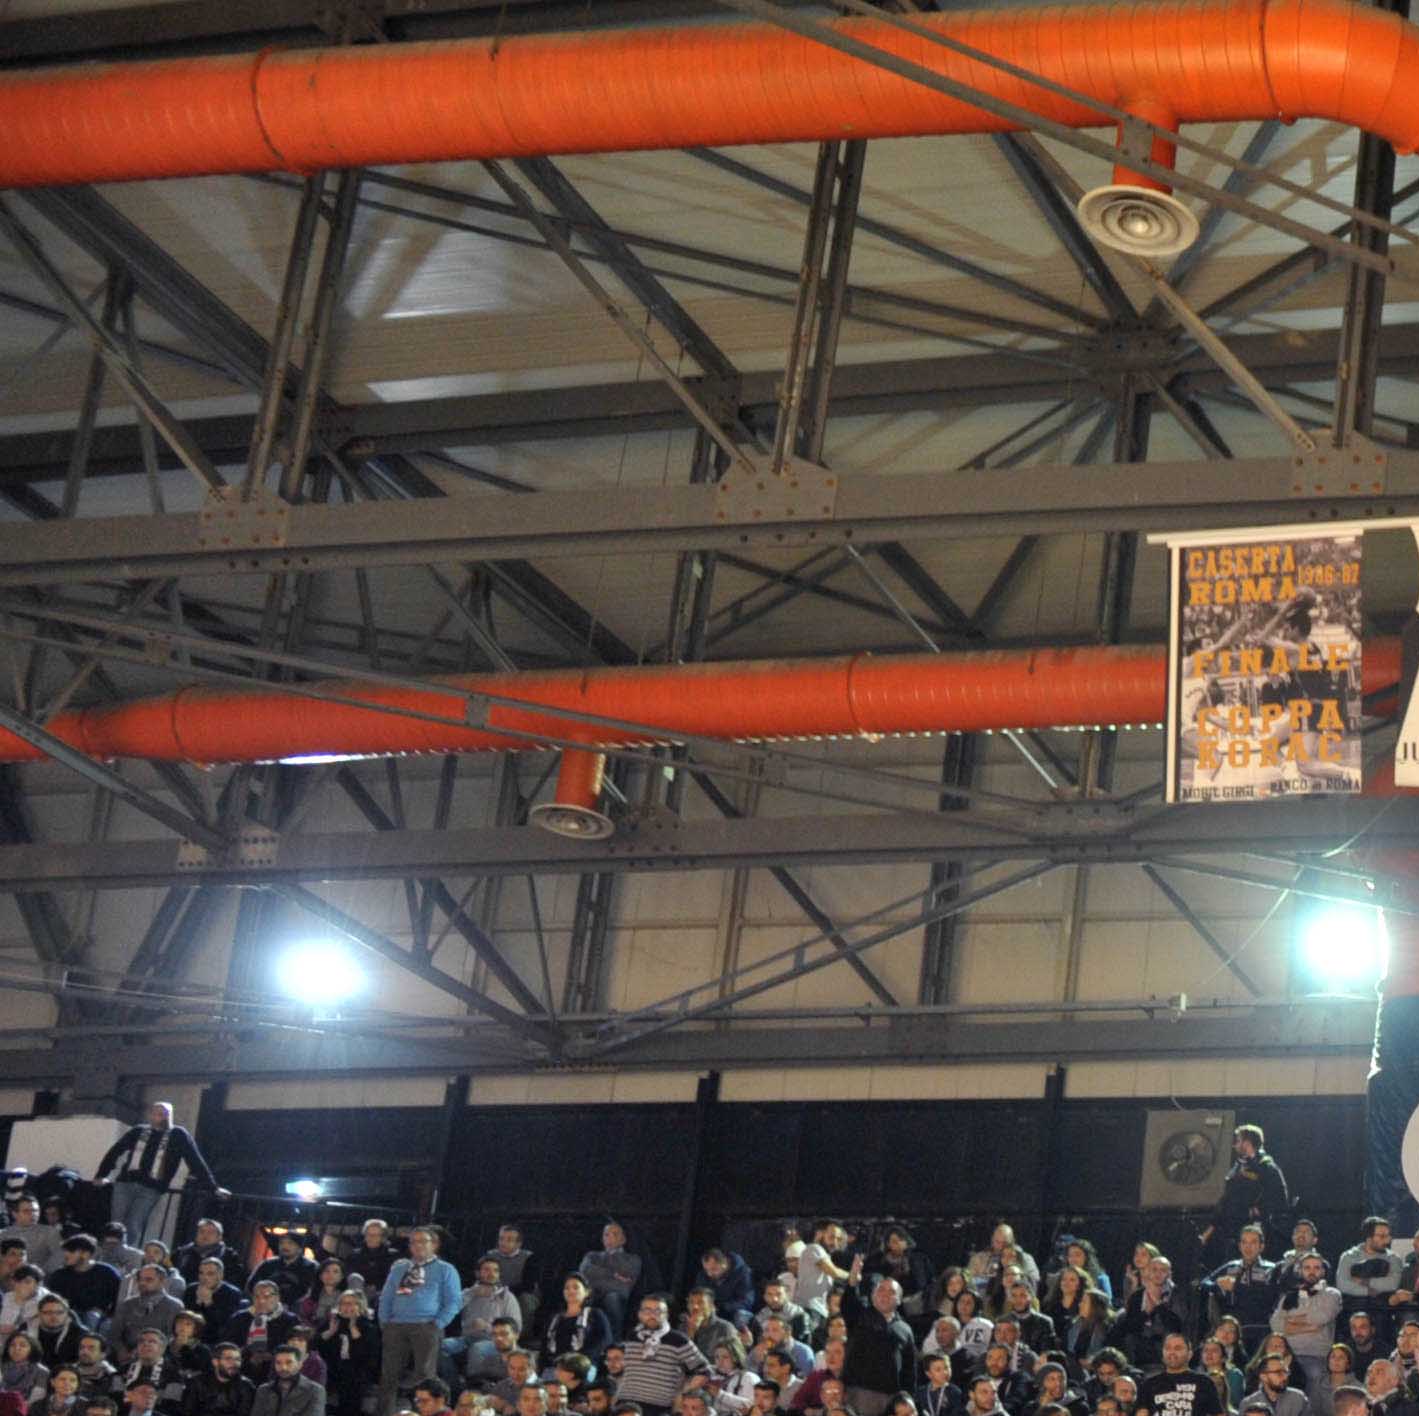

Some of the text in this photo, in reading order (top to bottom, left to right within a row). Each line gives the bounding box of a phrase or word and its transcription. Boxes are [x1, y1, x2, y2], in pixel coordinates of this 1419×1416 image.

[1188, 544, 1296, 579] CASERTA
[1188, 576, 1297, 606] ROMA
[1192, 643, 1350, 679] FINALE
[1198, 699, 1344, 737] COPPA
[1197, 731, 1343, 770] KORAC
